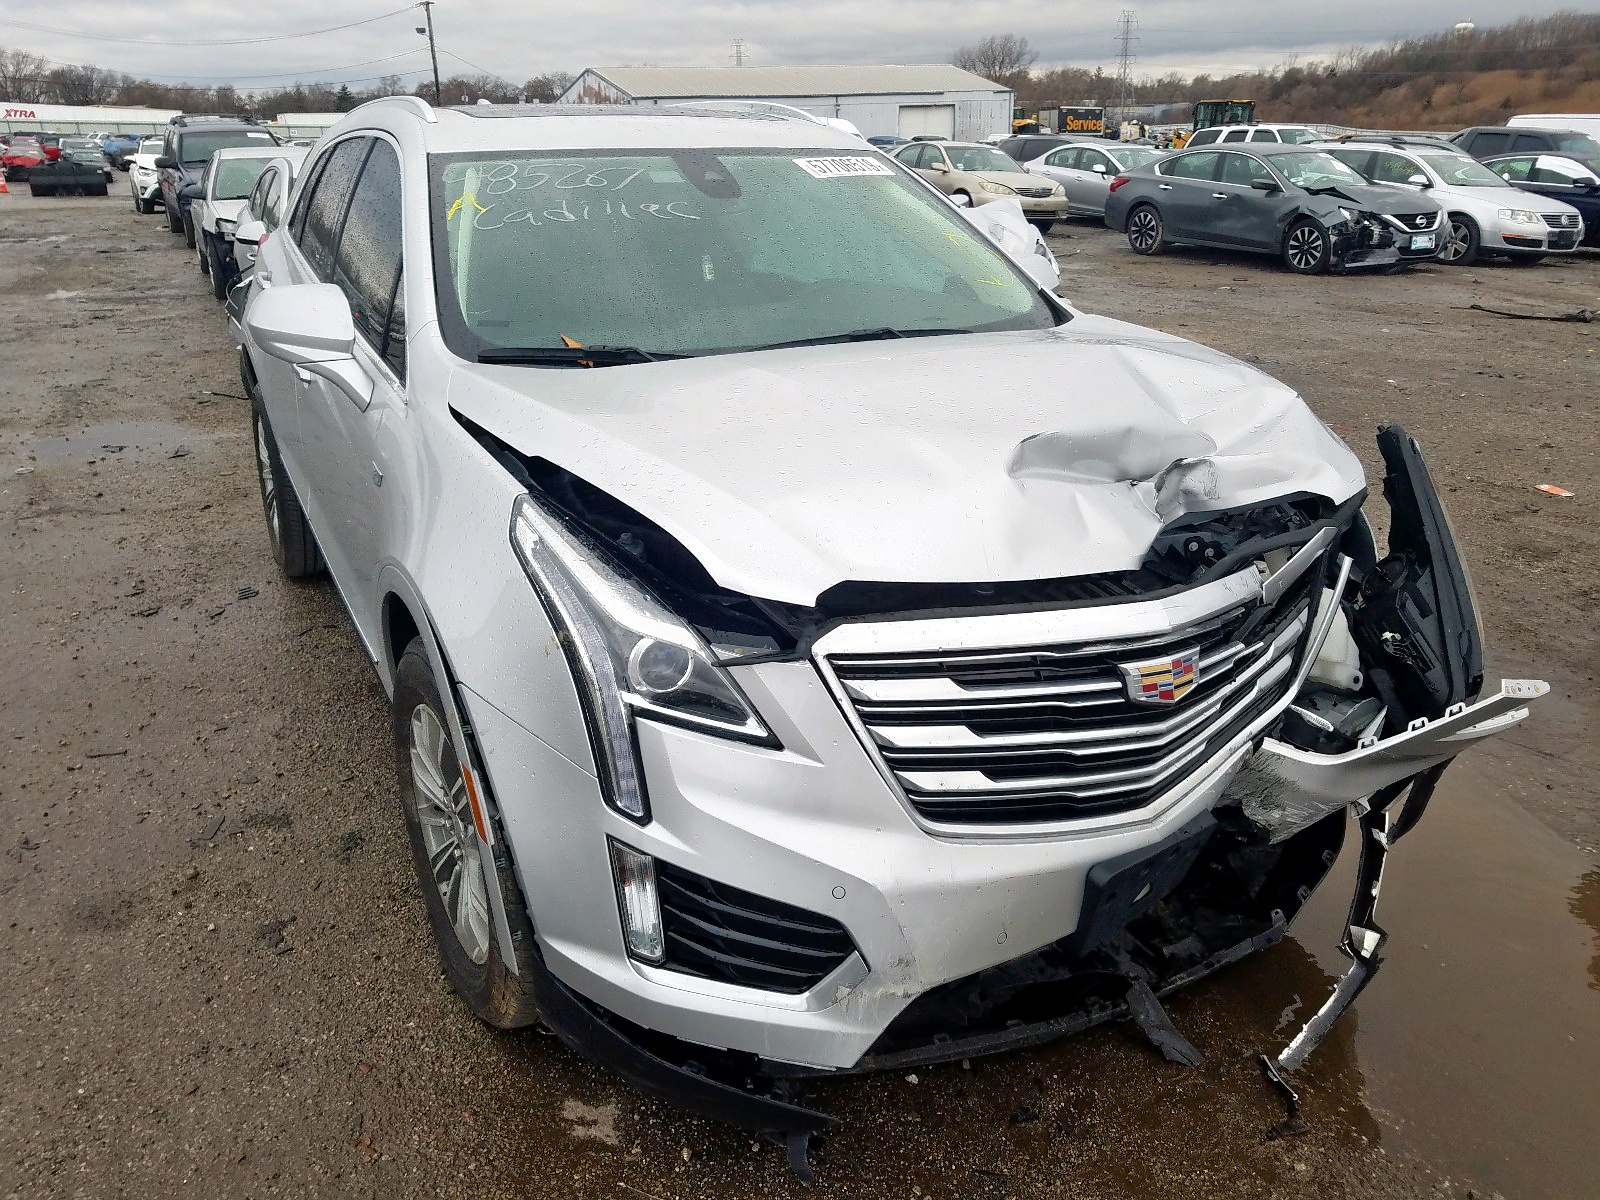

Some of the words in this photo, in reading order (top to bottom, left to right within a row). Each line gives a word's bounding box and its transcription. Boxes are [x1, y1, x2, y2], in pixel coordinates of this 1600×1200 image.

[3, 109, 36, 119] XTRA
[1066, 115, 1103, 131] Service
[474, 199, 701, 230] Cadillac
